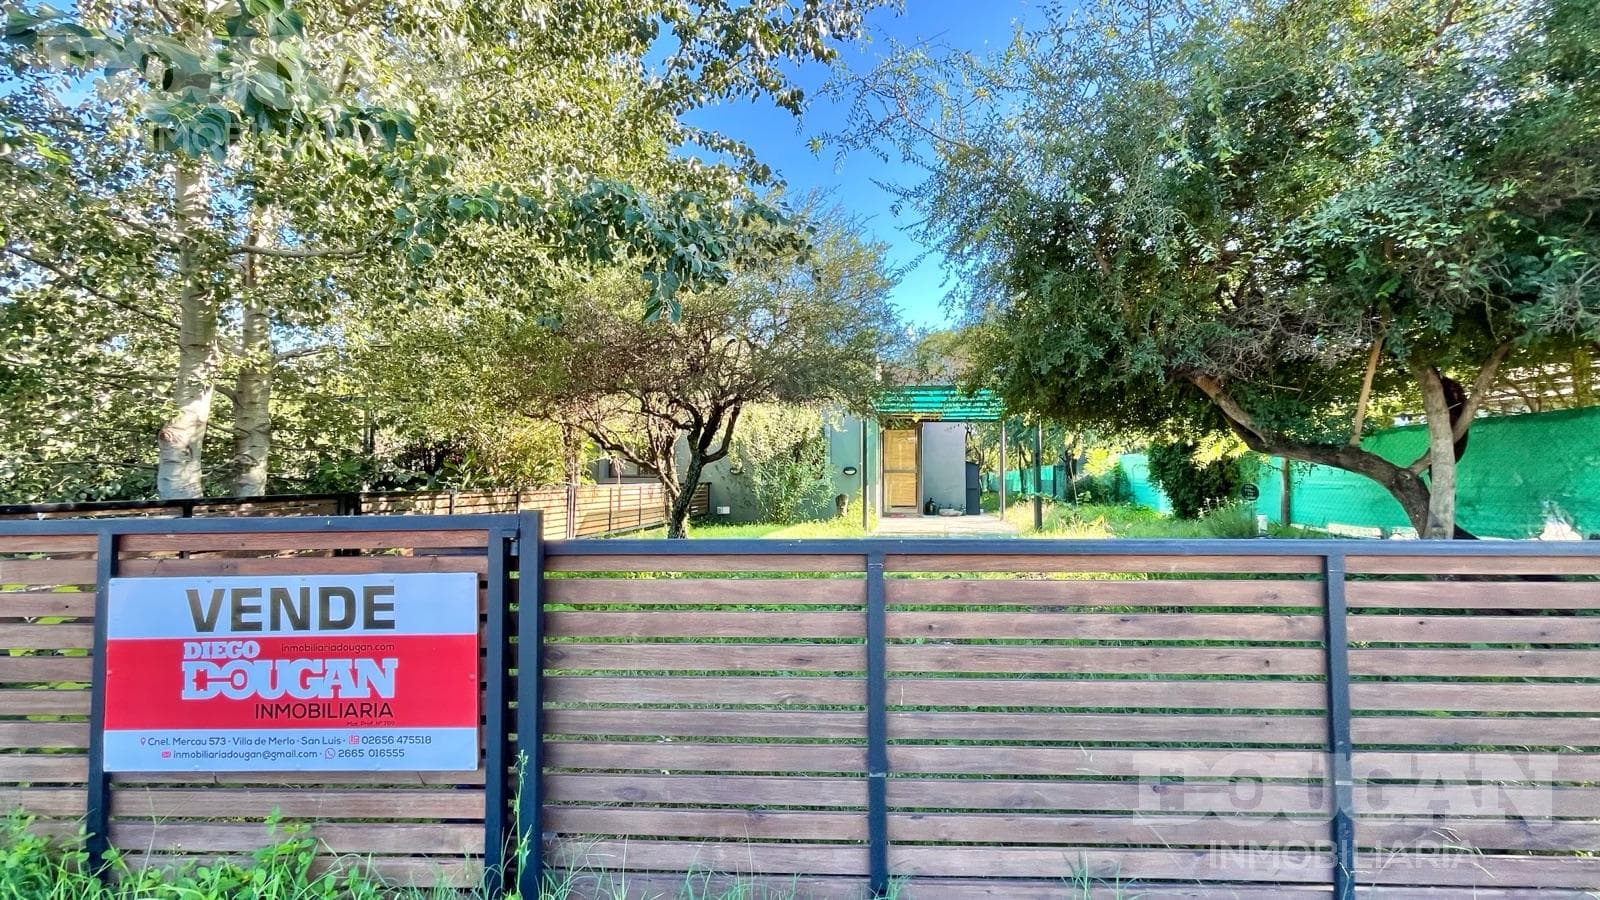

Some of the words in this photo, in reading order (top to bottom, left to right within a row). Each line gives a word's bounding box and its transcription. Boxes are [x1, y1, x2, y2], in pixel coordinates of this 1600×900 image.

[186, 585, 395, 632] VENDE
[183, 641, 260, 660] DIEGO
[281, 643, 395, 654] inmobiliariadougan.com
[182, 658, 398, 700] DOUGAN
[255, 702, 394, 719] INMOBILIARIA
[172, 737, 207, 746] Mercau
[208, 737, 226, 746] 573
[232, 737, 253, 746] Villa
[254, 737, 267, 746] de
[268, 736, 295, 745] Merlo
[301, 736, 320, 745] San
[322, 736, 341, 745] Luis
[361, 735, 394, 745] 02656
[396, 735, 432, 745] 475518
[173, 749, 318, 761] inmobiliariadougan@gmail.com
[338, 748, 364, 758] 2665
[368, 748, 405, 758] 016555
